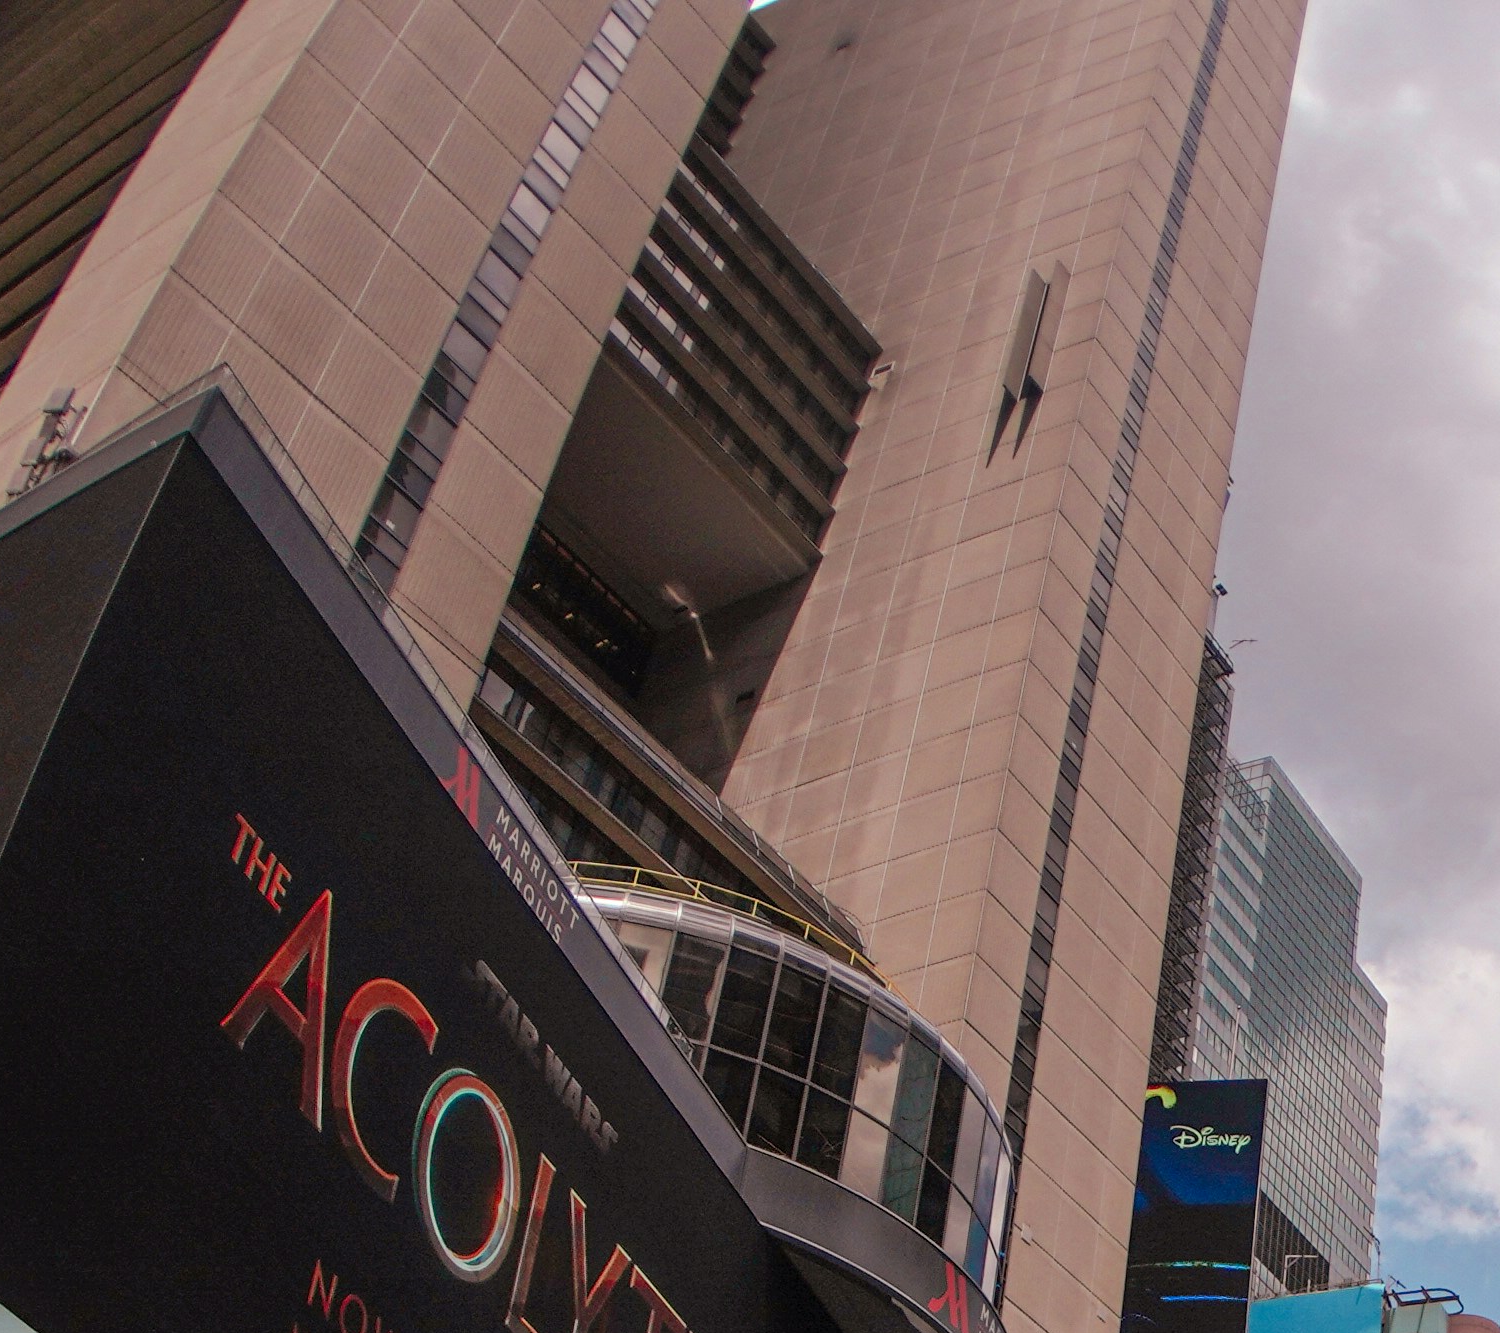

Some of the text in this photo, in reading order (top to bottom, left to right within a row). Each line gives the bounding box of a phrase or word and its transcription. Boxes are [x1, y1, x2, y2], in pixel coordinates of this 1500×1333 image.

[231, 812, 292, 913] THE
[488, 834, 564, 945] MARQUIS
[496, 805, 580, 930] MARRIOTT
[1170, 1124, 1252, 1154] Disney
